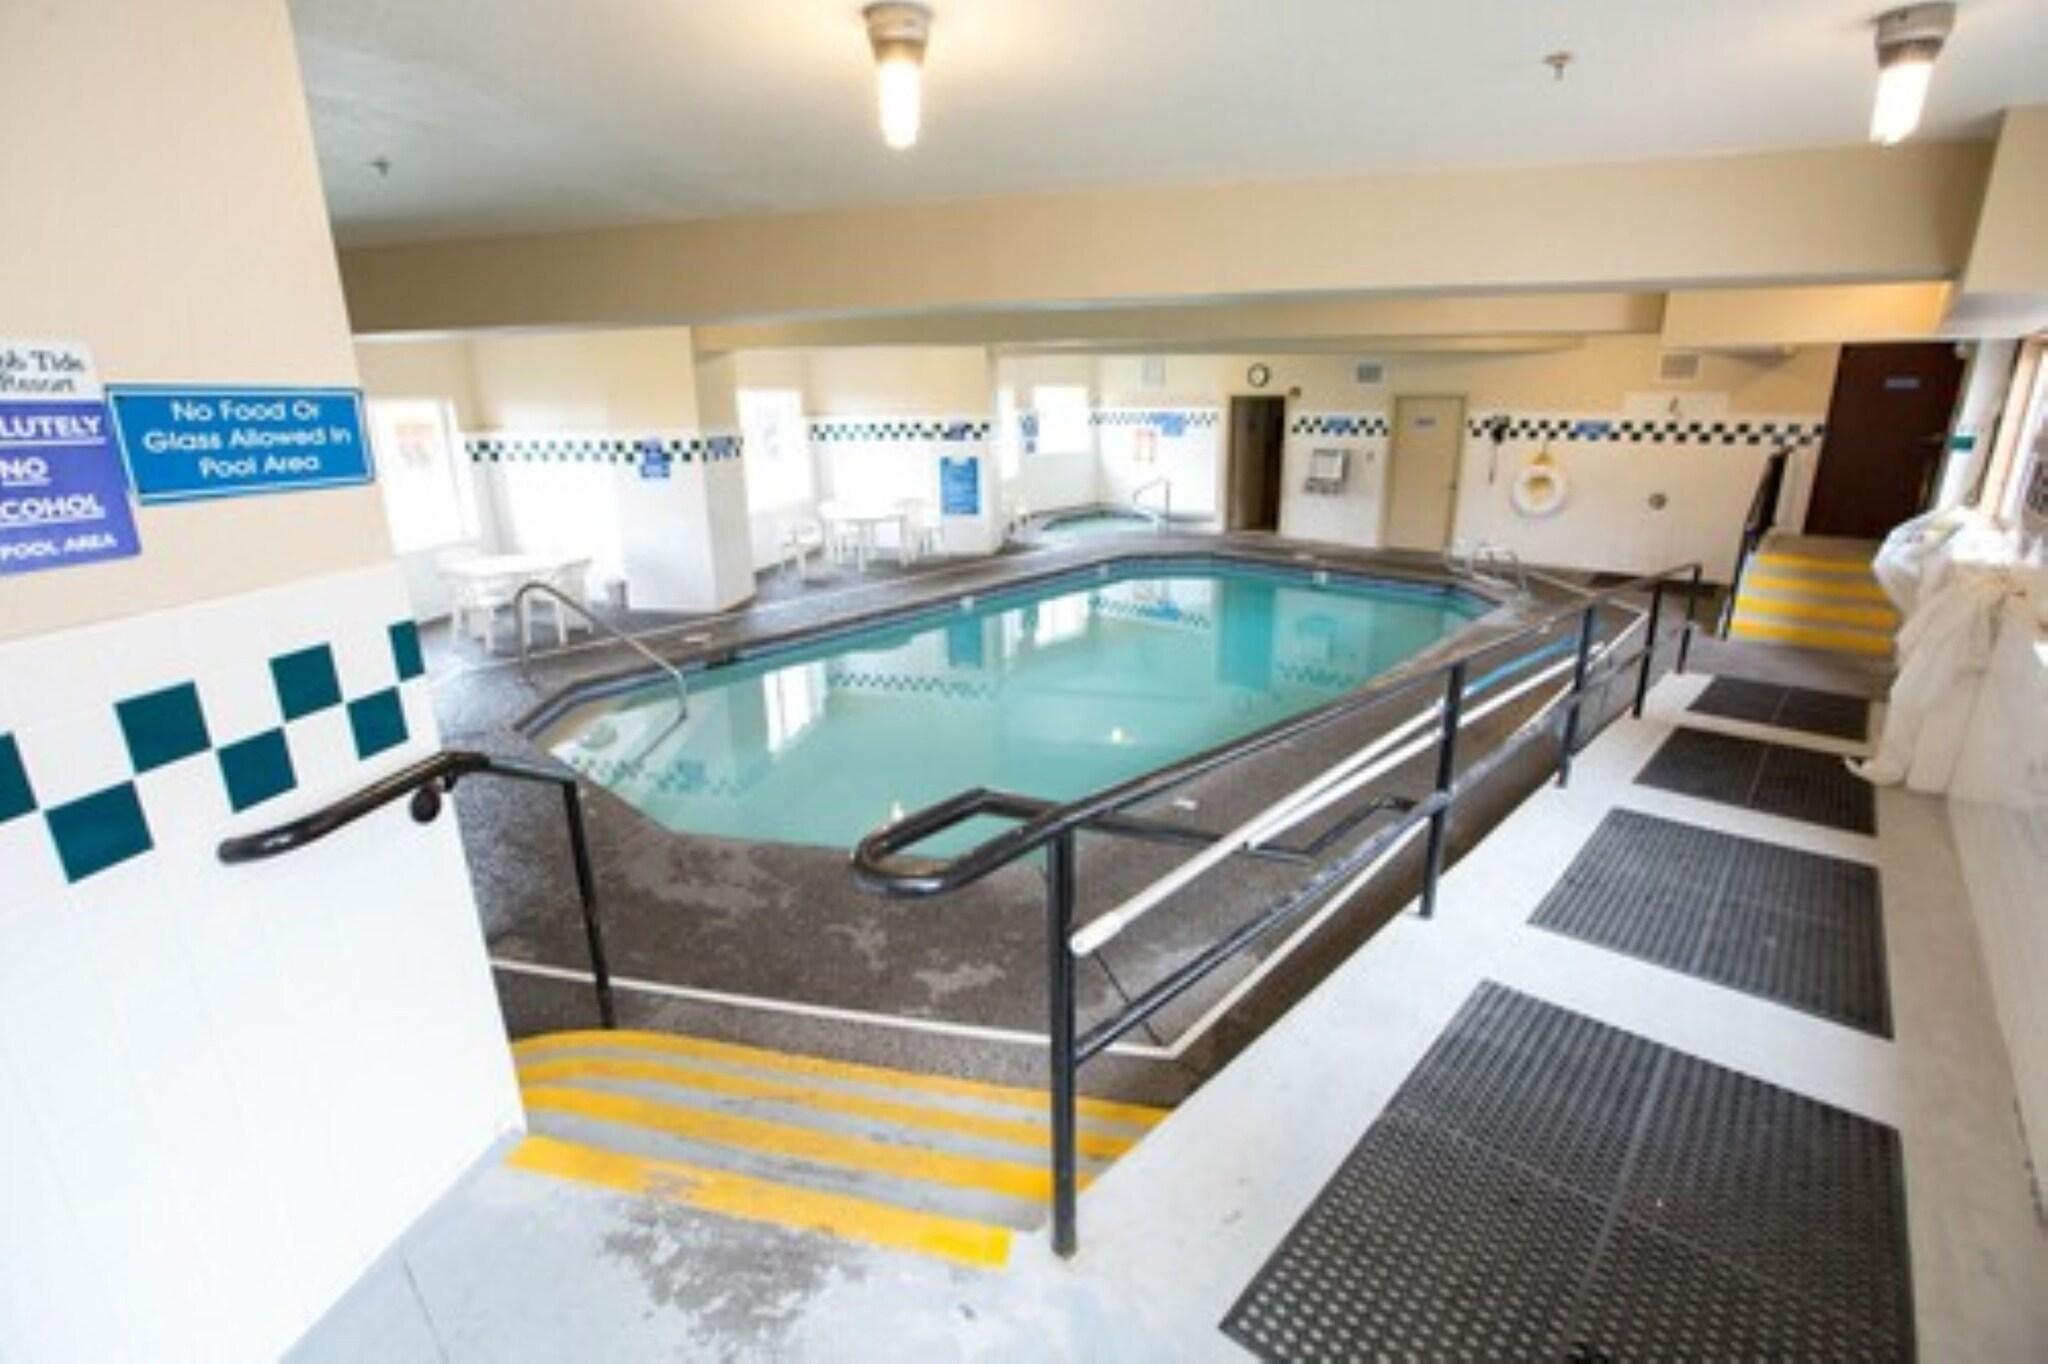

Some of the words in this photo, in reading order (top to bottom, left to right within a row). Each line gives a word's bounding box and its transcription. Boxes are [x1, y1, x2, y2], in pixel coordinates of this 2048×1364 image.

[170, 400, 214, 421] No
[219, 399, 286, 421] Food
[292, 399, 320, 420] Or
[0, 415, 102, 438] LUTELY
[141, 430, 222, 454] Glass
[228, 427, 326, 449] Allowed
[328, 425, 351, 444] In
[0, 456, 49, 480] NO
[199, 457, 257, 478] Pool
[263, 455, 320, 474] Area
[0, 493, 105, 520] COHOL
[0, 540, 60, 560] POOL
[62, 533, 119, 552] AREA
